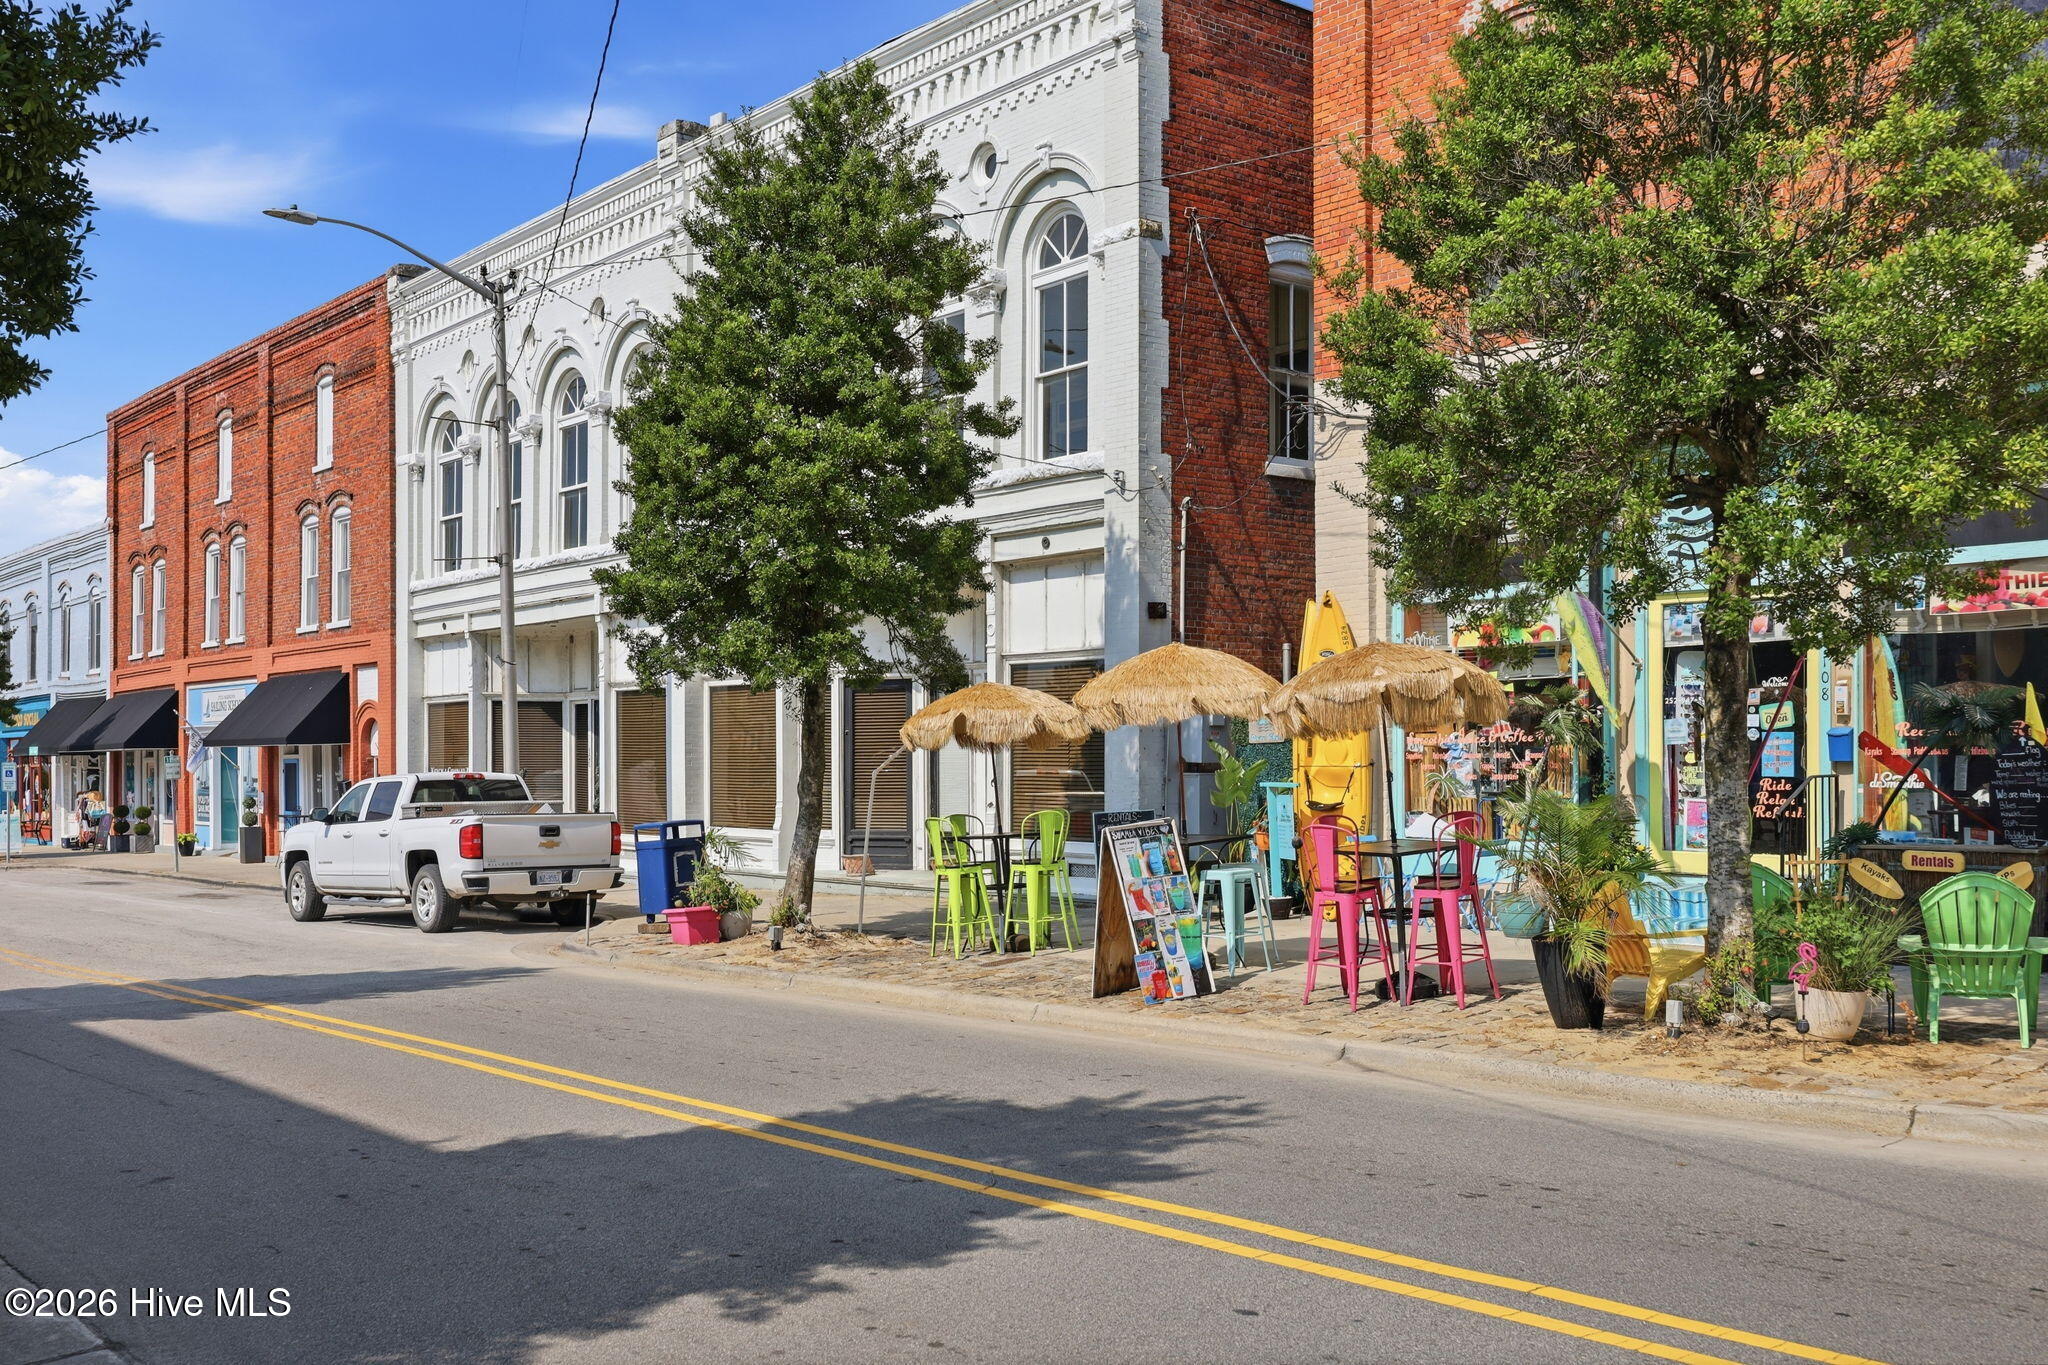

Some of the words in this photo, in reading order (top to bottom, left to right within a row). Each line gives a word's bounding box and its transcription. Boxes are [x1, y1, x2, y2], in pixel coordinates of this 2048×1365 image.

[1765, 715, 1788, 724] Oen
[1500, 728, 1534, 745] Coffee
[1760, 777, 1792, 791] Ride
[1911, 855, 1954, 868] Rentals
[1861, 862, 1891, 883] Kayaks
